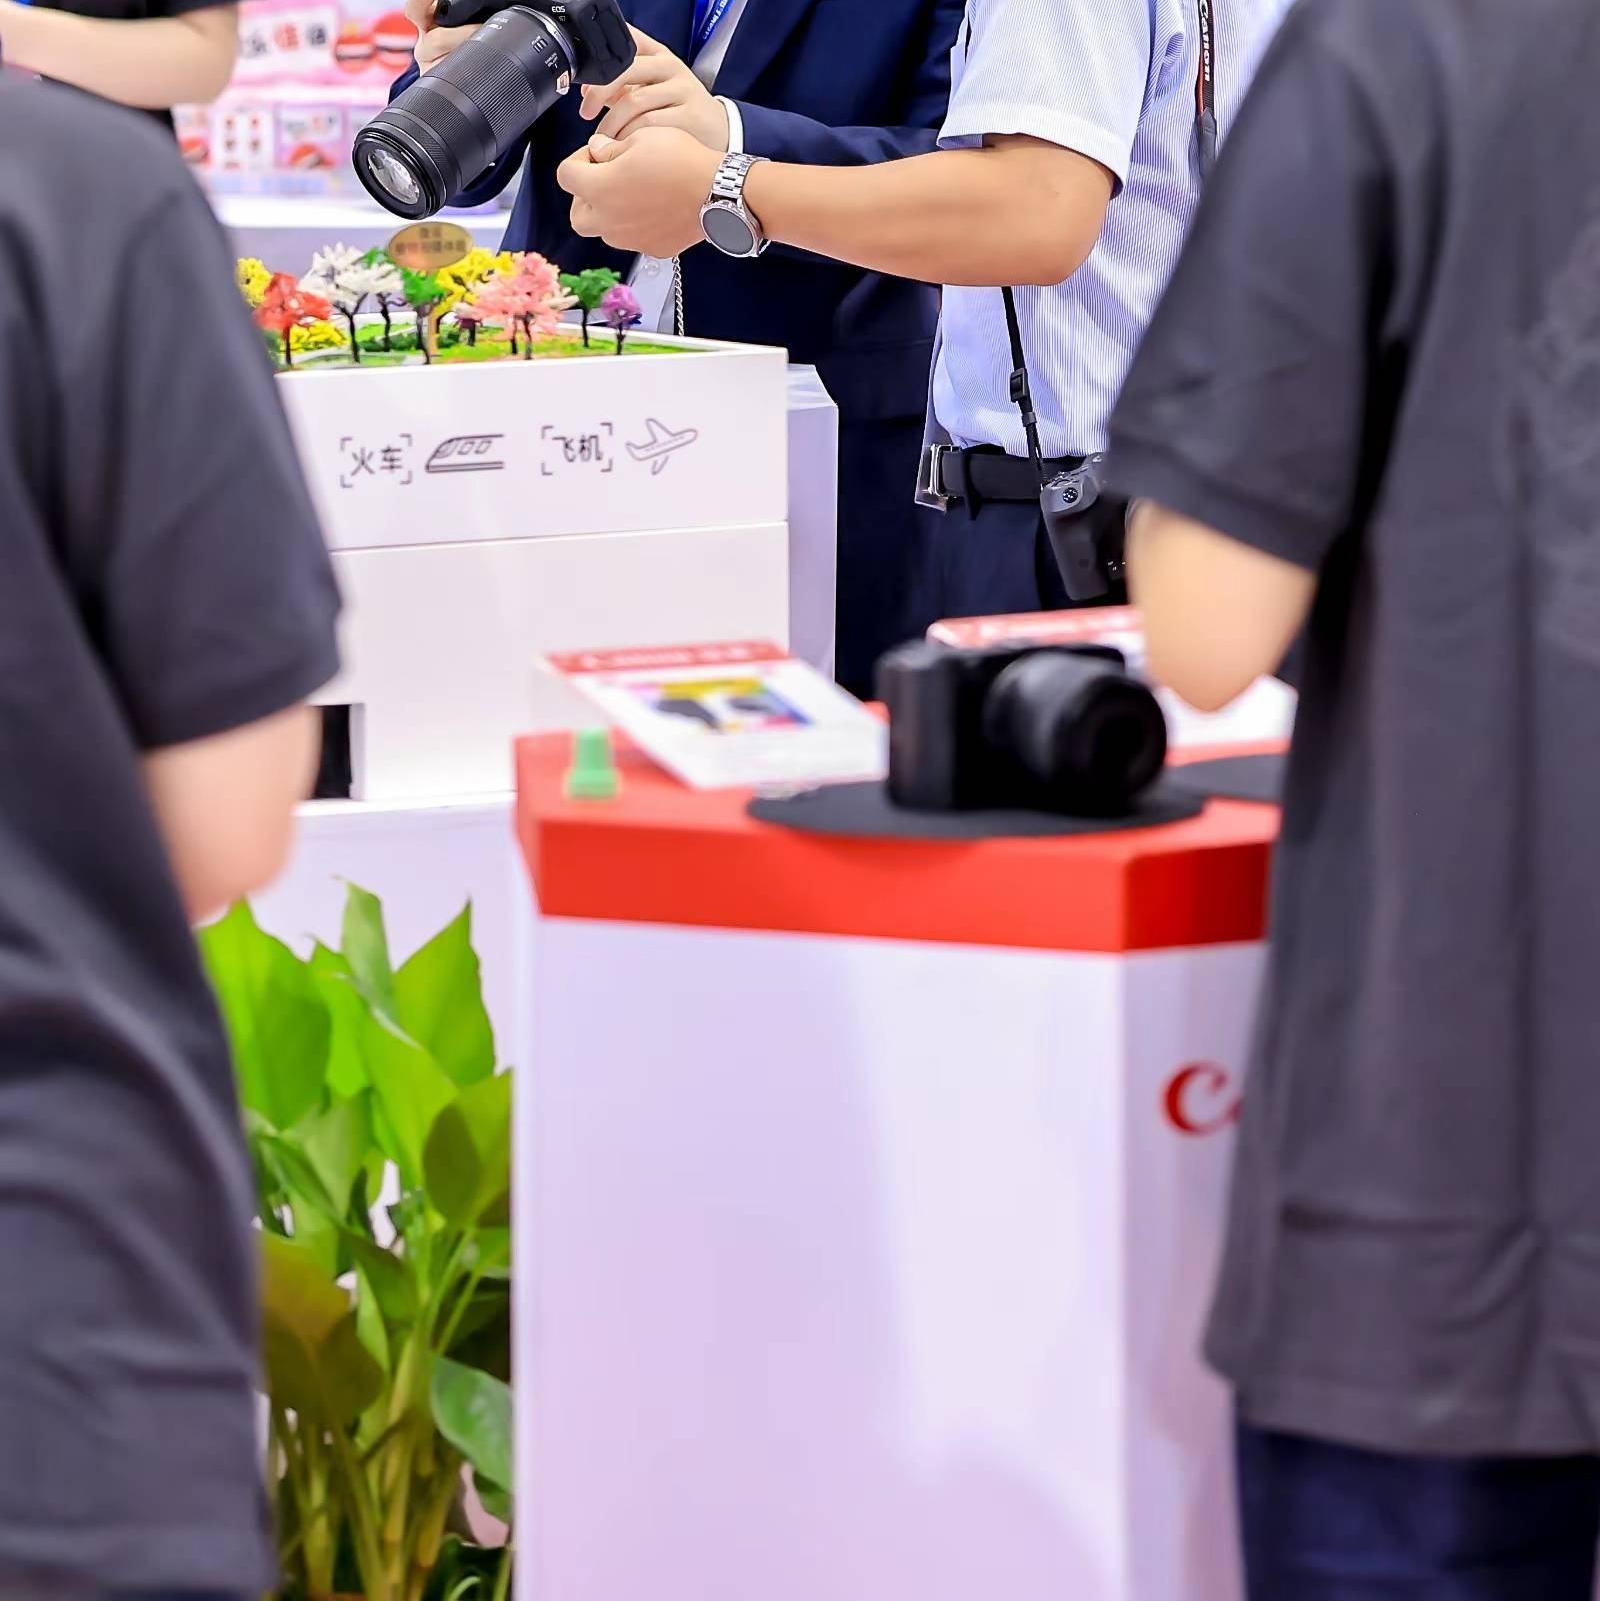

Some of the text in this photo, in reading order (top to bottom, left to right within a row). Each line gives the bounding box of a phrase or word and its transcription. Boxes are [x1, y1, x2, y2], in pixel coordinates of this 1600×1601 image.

[551, 5, 566, 13] EOS
[351, 445, 403, 476] 火车
[552, 434, 602, 463] 飞机
